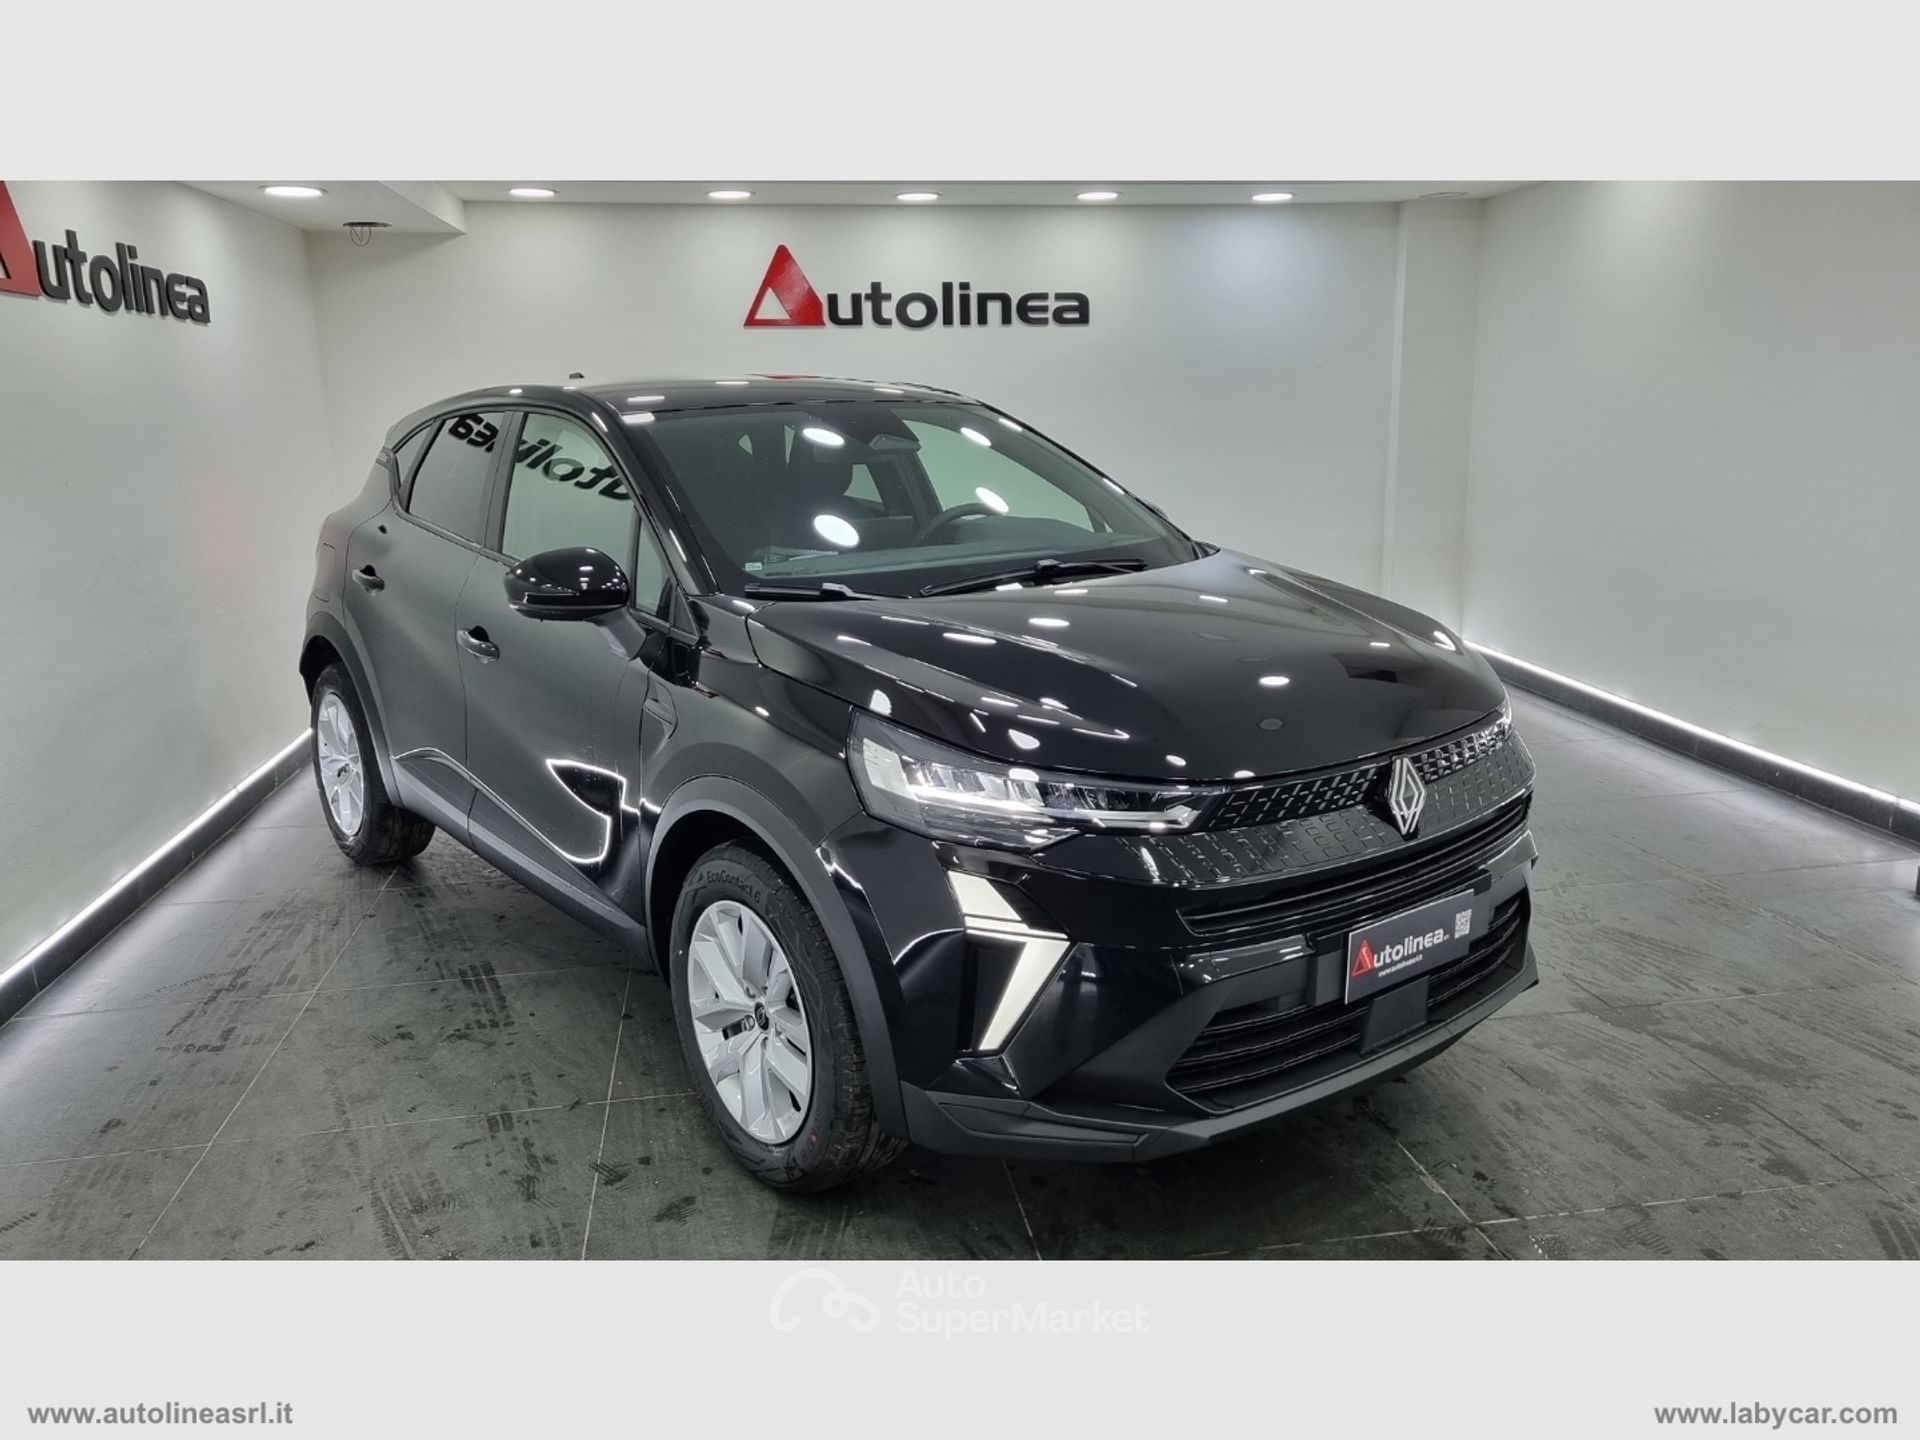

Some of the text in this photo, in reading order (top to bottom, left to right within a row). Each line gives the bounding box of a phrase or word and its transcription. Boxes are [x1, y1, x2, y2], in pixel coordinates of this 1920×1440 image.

[743, 243, 1090, 327] Autolinea
[706, 869, 761, 904] EcoContact 6
[1352, 928, 1444, 977] Autolinea
